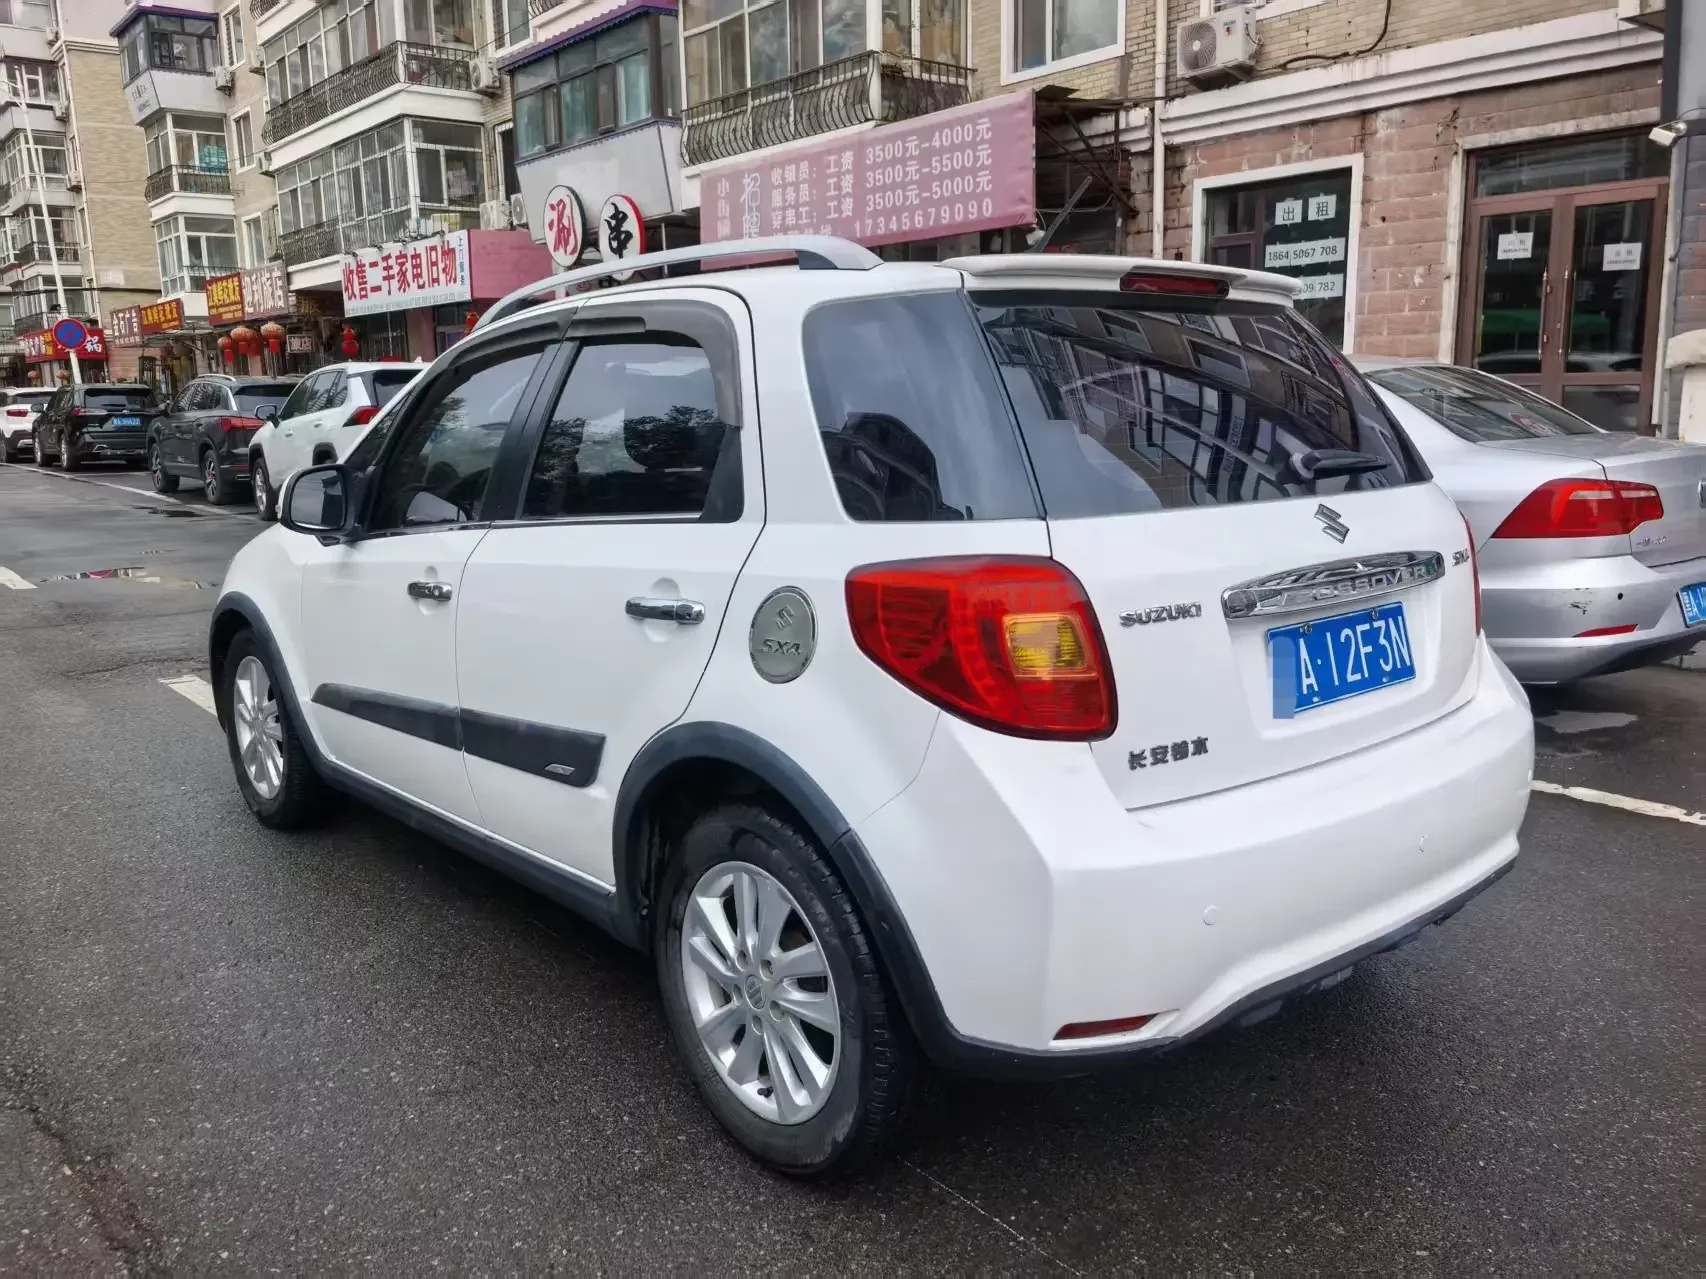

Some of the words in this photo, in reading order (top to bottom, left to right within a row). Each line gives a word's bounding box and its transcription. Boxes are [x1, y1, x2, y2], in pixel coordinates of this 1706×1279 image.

[825, 151, 854, 174] 工资
[866, 117, 992, 165] 3500元-4000元
[825, 174, 854, 197] 工资
[866, 143, 992, 189] 3500元-5500元
[825, 197, 854, 219] 工资
[866, 170, 992, 212] 3500元-5000元
[1282, 205, 1295, 221] 出
[1315, 201, 1329, 217] 租
[854, 198, 993, 238] 17345679090
[342, 239, 458, 301] 收售二手家电旧物
[1268, 250, 1290, 262] 1864
[1293, 248, 1316, 260] 5067
[1319, 245, 1338, 257] 708
[1318, 281, 1335, 292] 782
[1119, 601, 1202, 627] SUZUKI
[1128, 736, 1209, 771] 长安铃木
